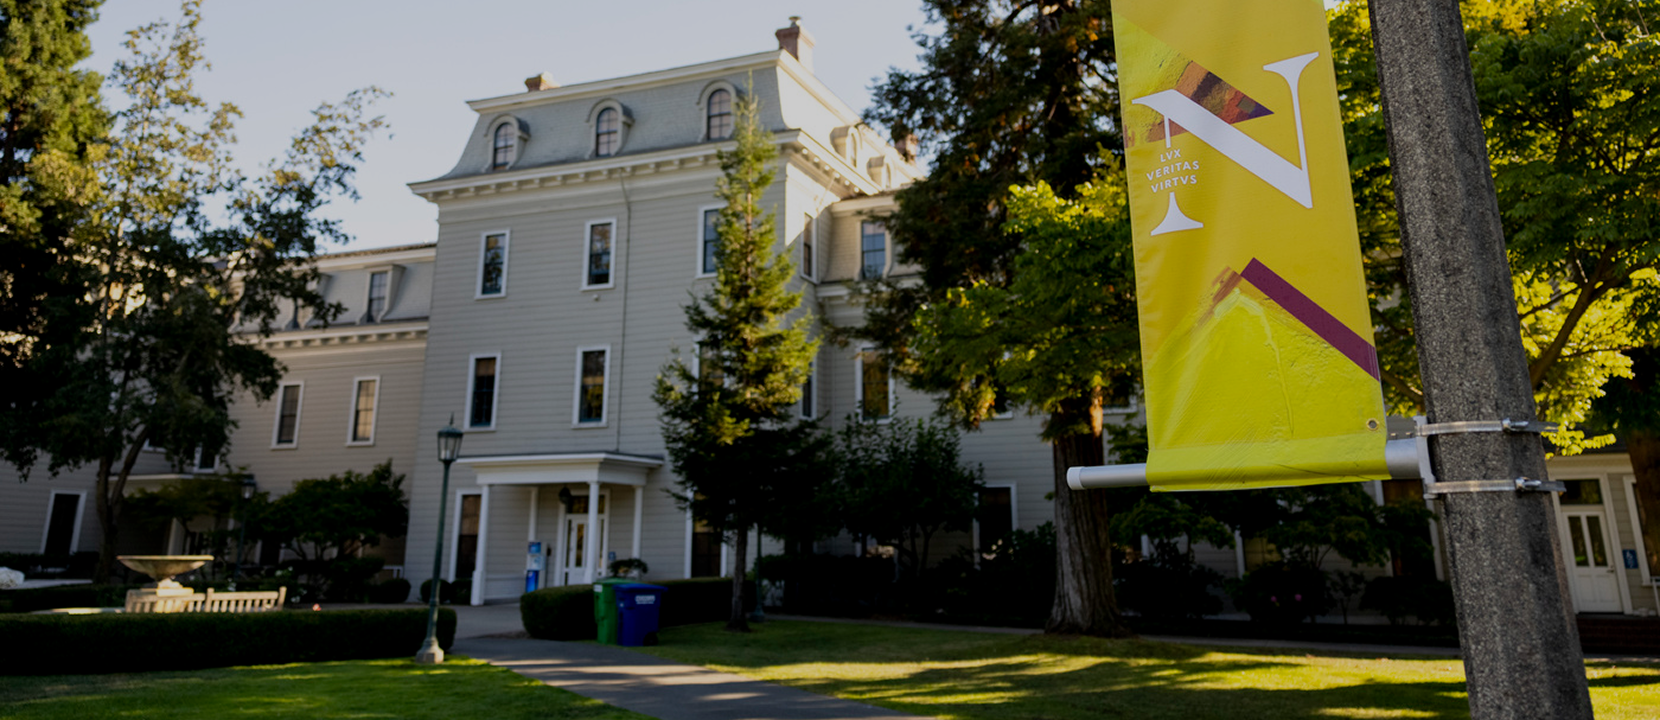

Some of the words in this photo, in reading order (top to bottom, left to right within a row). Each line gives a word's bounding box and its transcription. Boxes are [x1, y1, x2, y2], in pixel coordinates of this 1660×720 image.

[1132, 52, 1319, 236] N
[1160, 149, 1181, 163] LVX
[1146, 160, 1200, 181] VERITAS
[1151, 174, 1197, 193] VIRTVS
